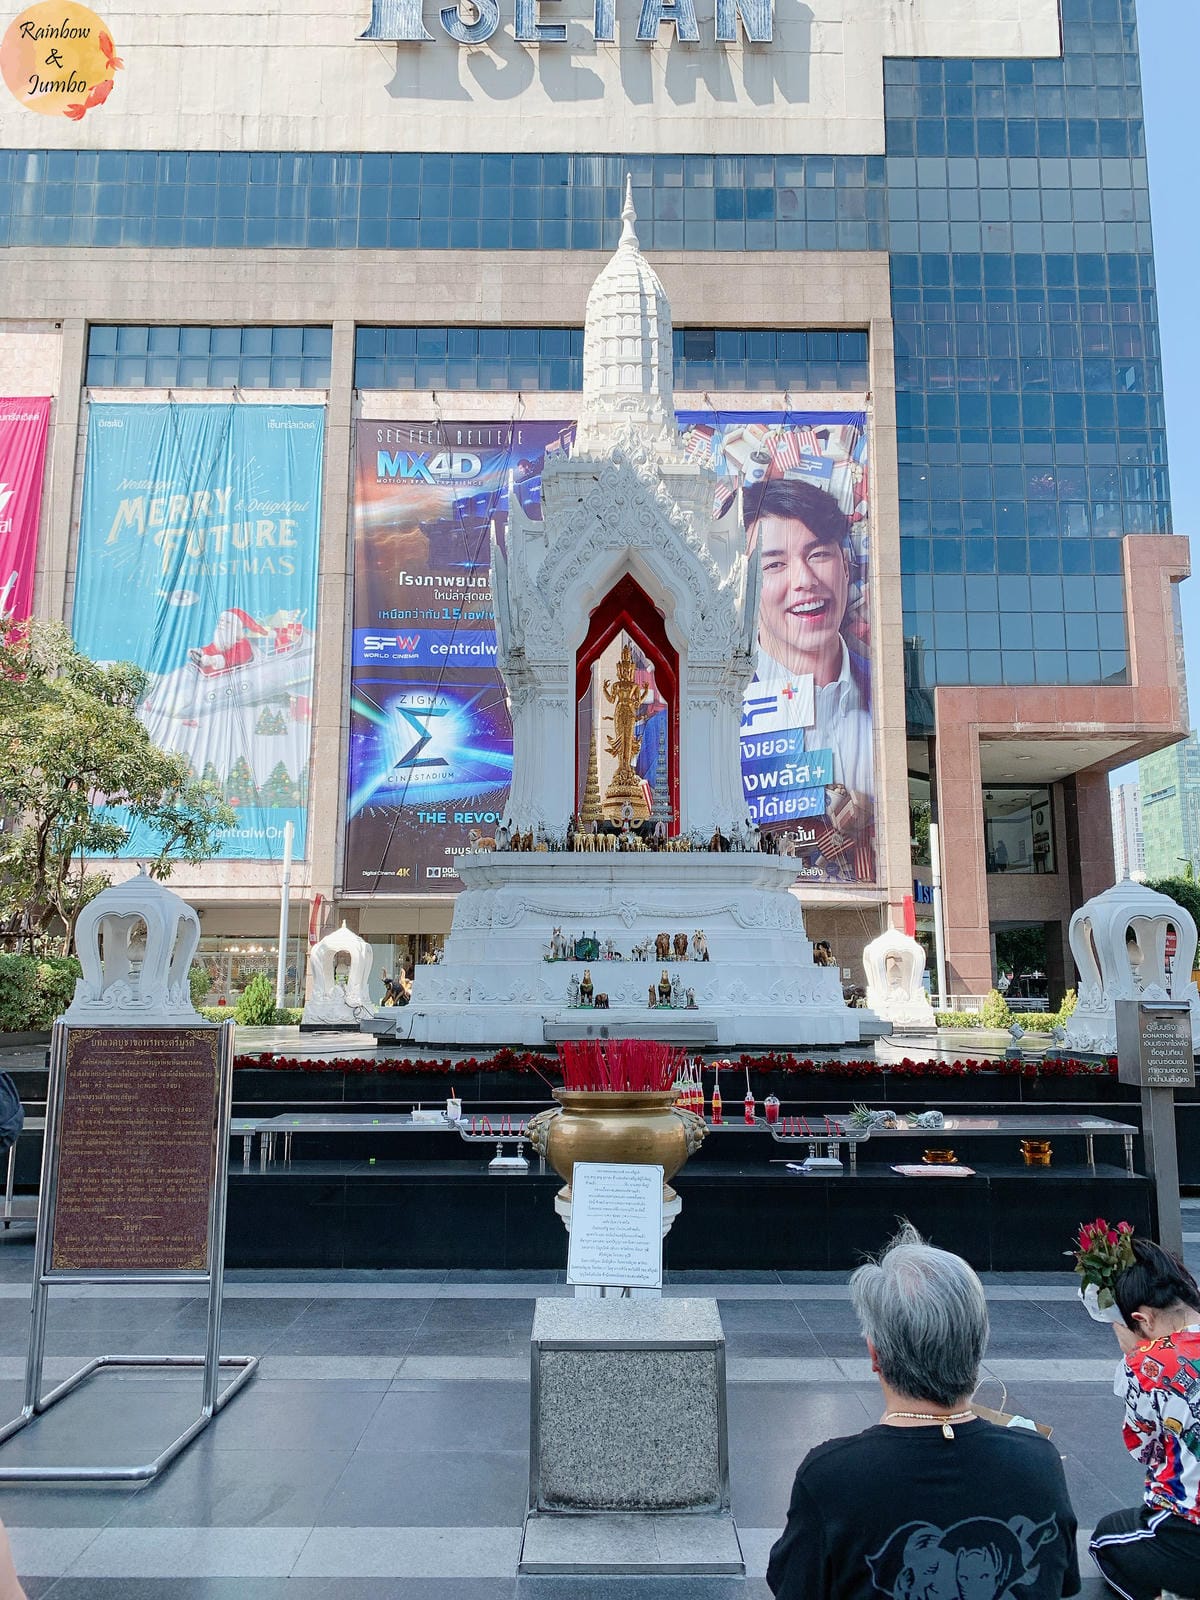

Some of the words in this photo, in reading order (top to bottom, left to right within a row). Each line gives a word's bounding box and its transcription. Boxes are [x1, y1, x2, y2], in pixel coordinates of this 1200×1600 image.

[377, 429, 401, 443] SEE
[409, 430, 442, 444] FEEL
[457, 430, 523, 445] BELIEVE
[376, 450, 482, 484] MX4D
[104, 485, 236, 546] MERRY
[153, 518, 299, 577] FUTURE
[442, 607, 462, 620] 15
[387, 773, 455, 783] CINESTADIUM
[417, 812, 447, 824] THE
[396, 868, 411, 877] 4K
